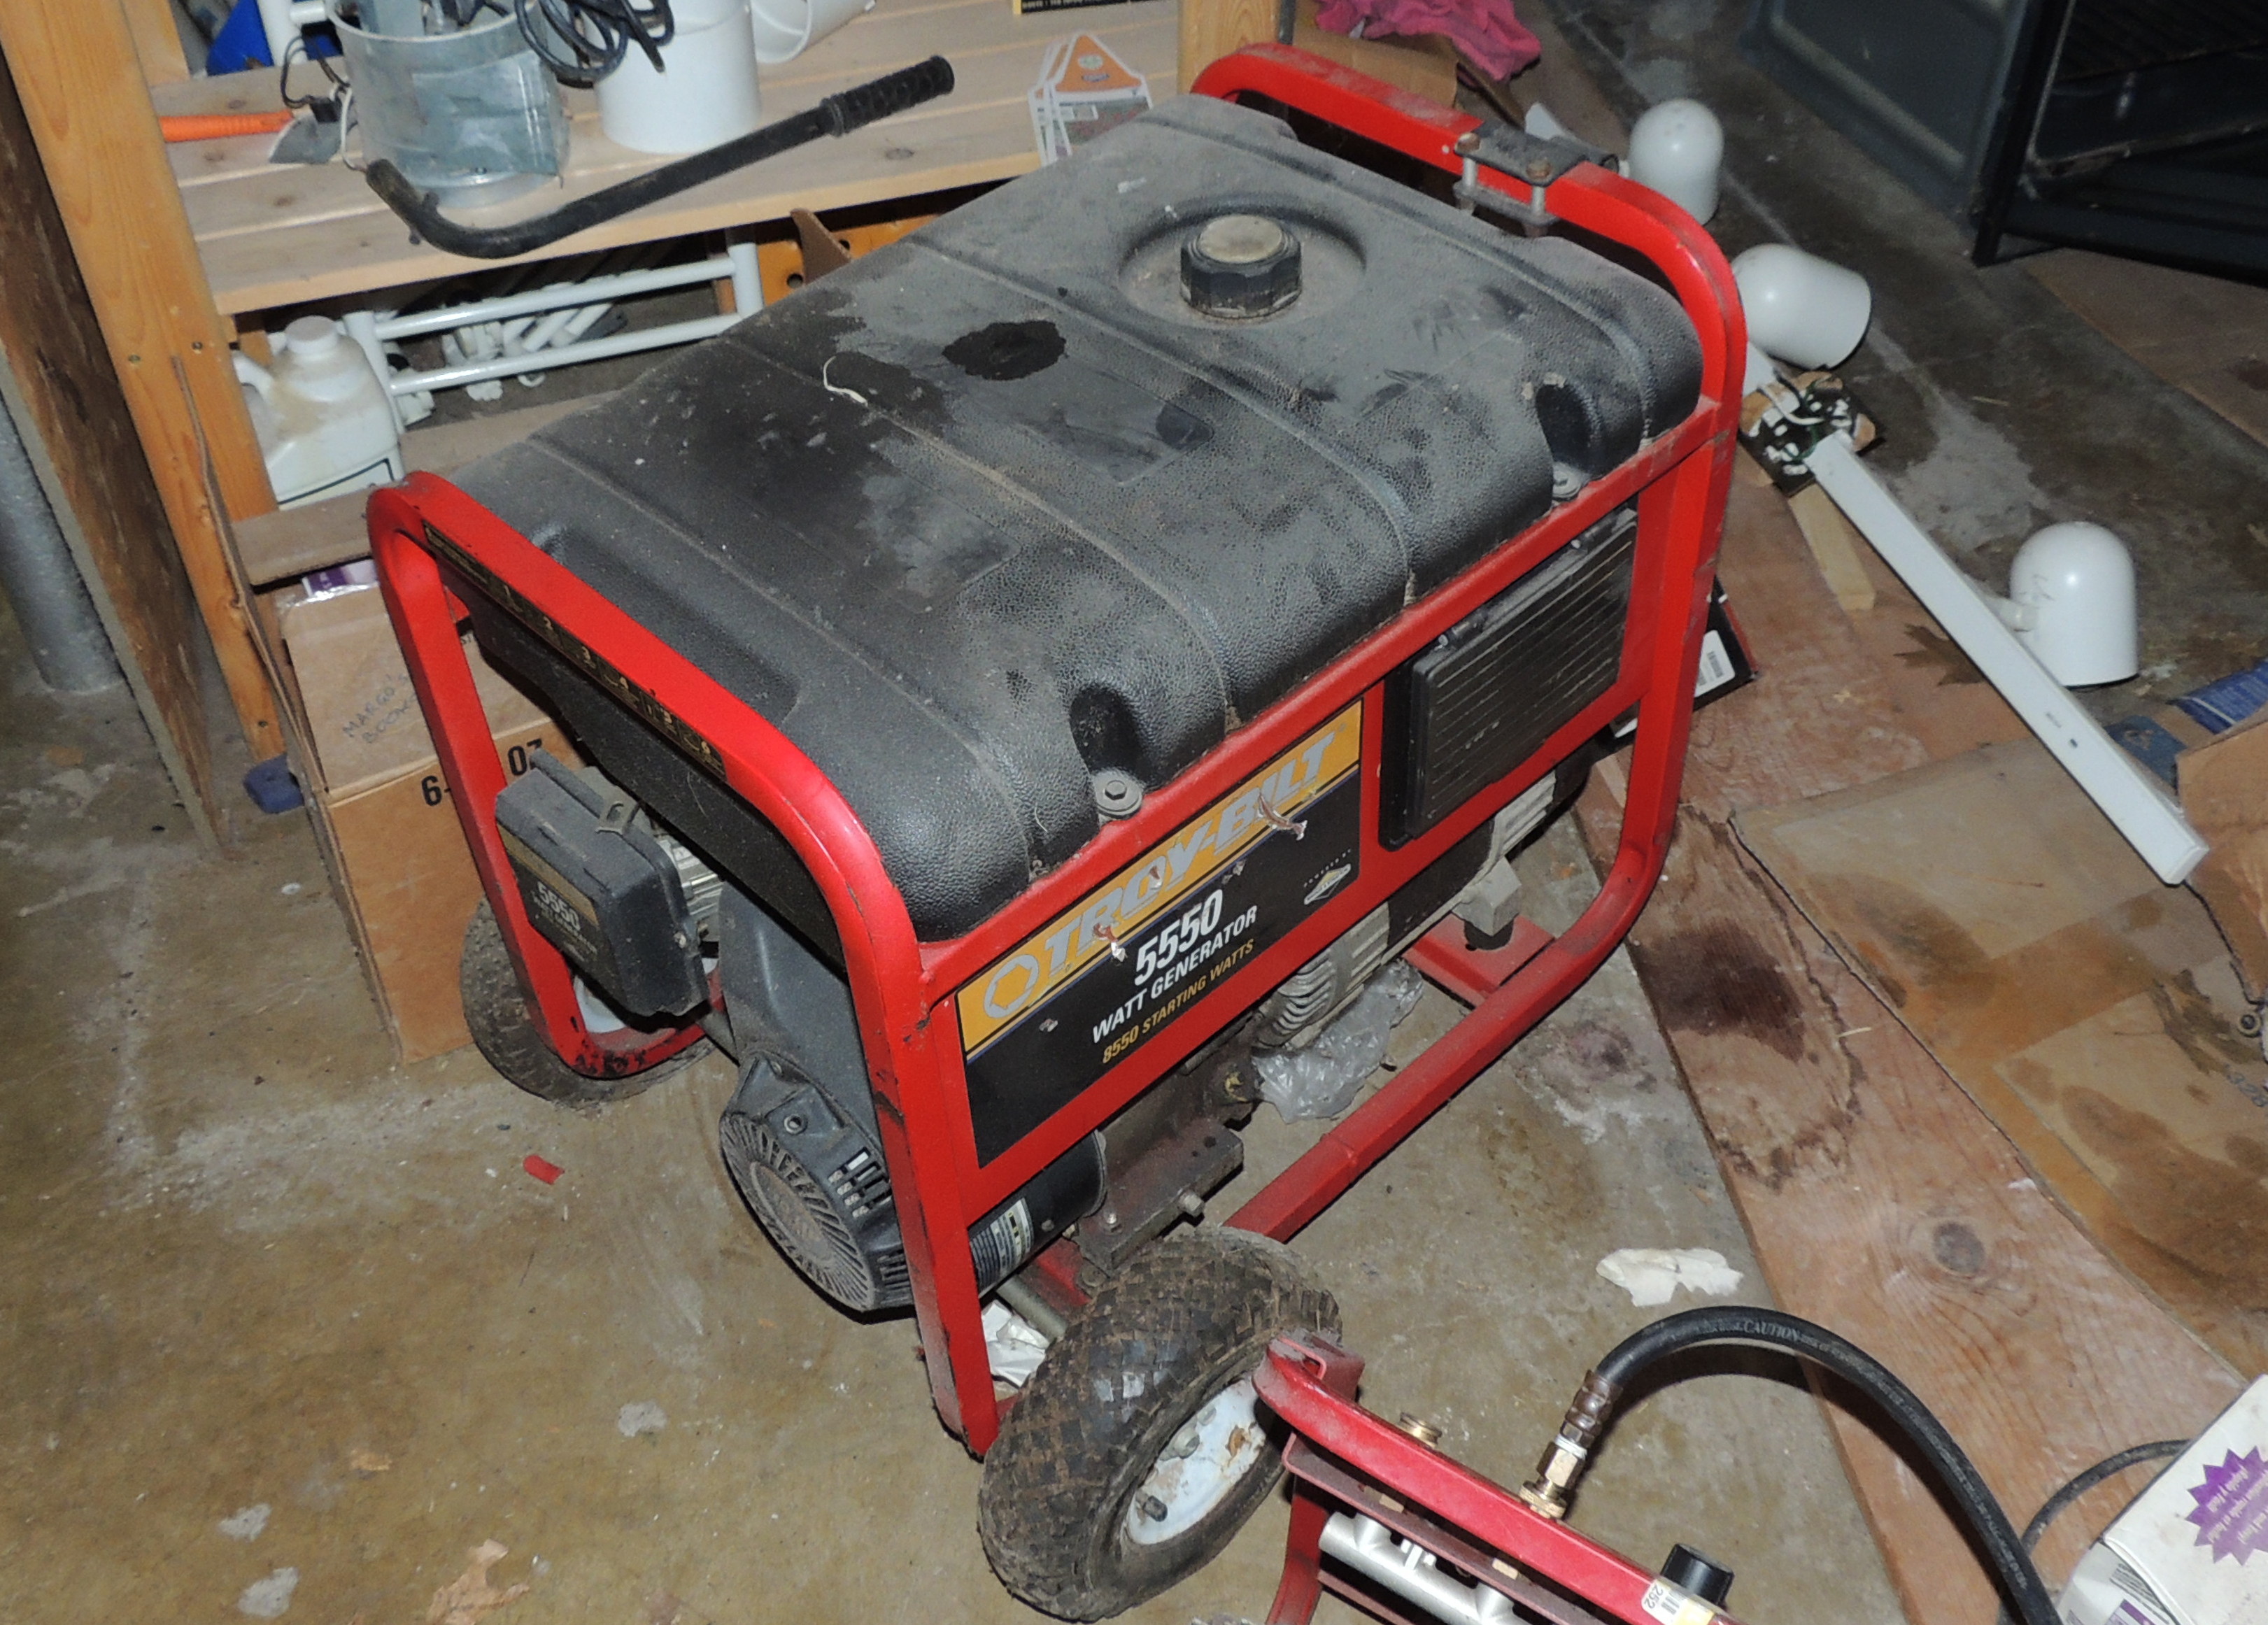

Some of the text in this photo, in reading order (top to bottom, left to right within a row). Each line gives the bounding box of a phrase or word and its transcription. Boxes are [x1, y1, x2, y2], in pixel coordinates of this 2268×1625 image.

[1044, 731, 1335, 971] TROY-BILT
[537, 881, 581, 931] 5550
[1134, 889, 1223, 986] 5550
[1093, 904, 1258, 1044] WATT GENERATOR
[1103, 938, 1254, 1064] 8550 STARTING WATTS
[1743, 1319, 1800, 1342] CAUTION
[1644, 1584, 1664, 1609] 252
